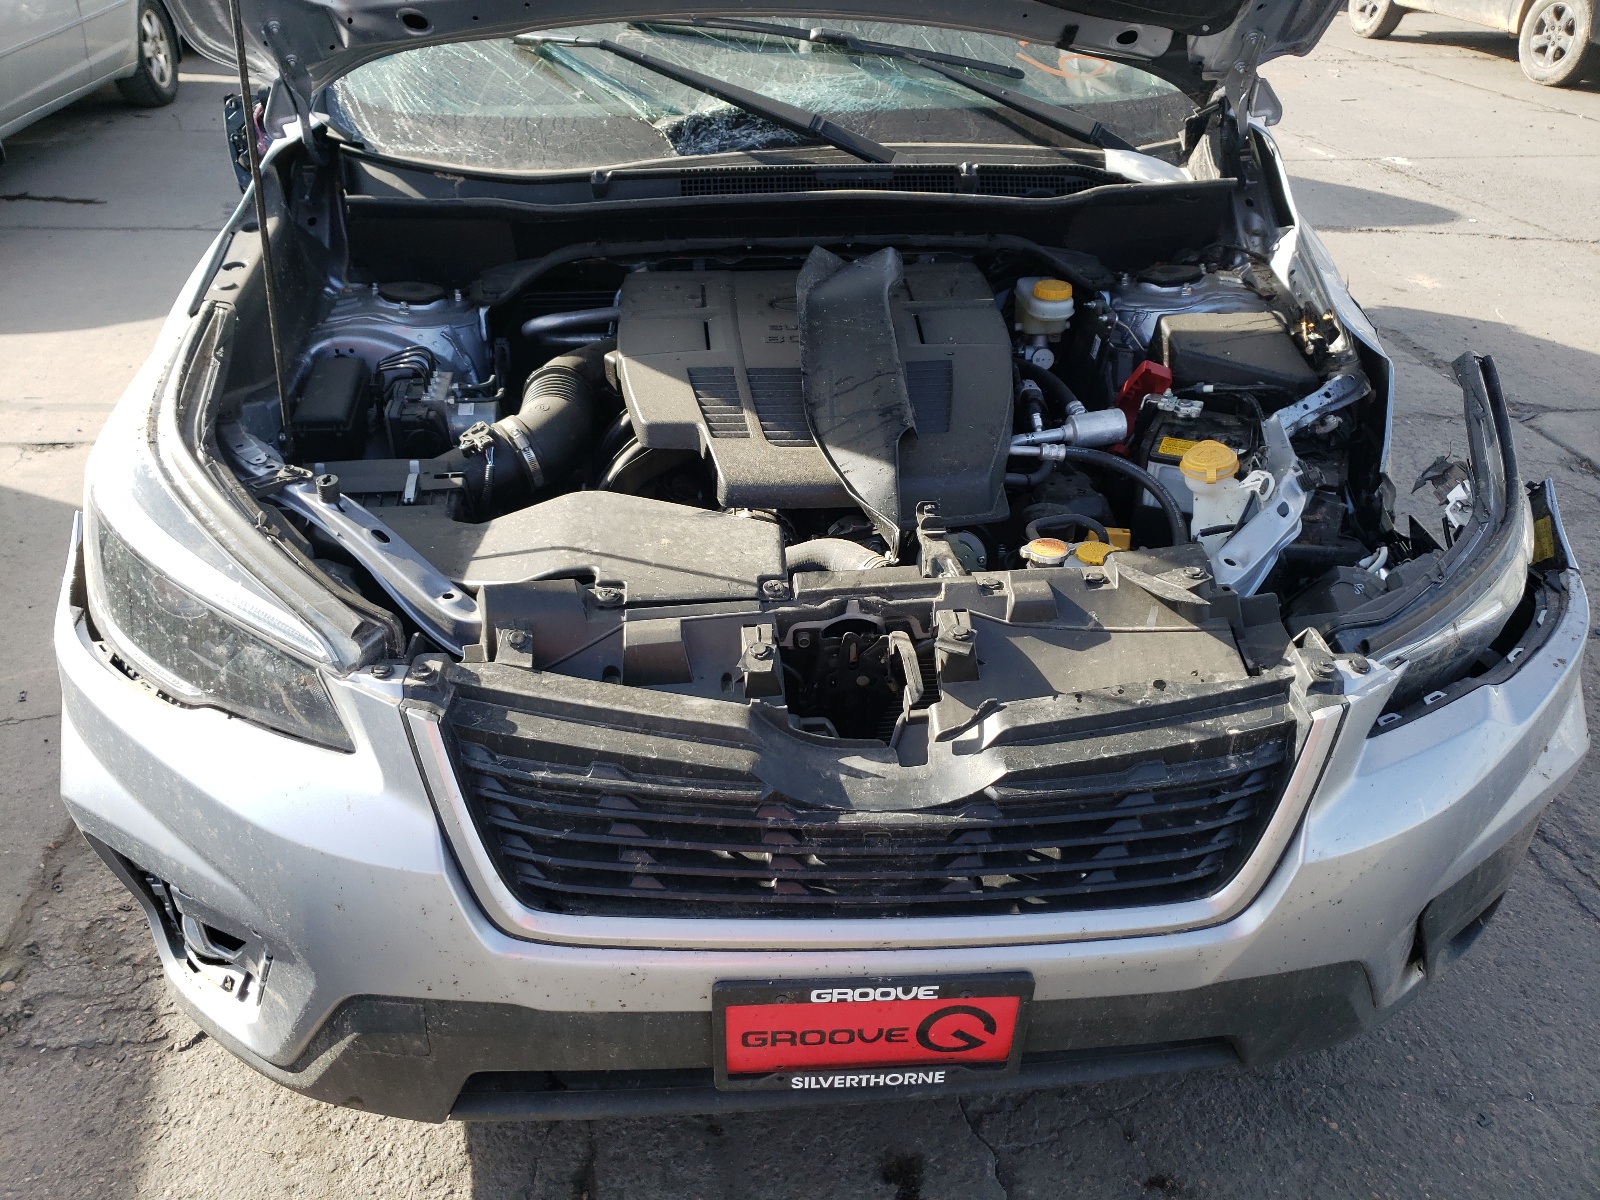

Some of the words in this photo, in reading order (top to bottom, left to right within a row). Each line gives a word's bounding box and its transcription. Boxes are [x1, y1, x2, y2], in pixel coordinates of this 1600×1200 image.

[811, 985, 940, 1003] GROOVE
[741, 1027, 910, 1048] GROOVE
[791, 1071, 946, 1089] SILVERTHORNE
